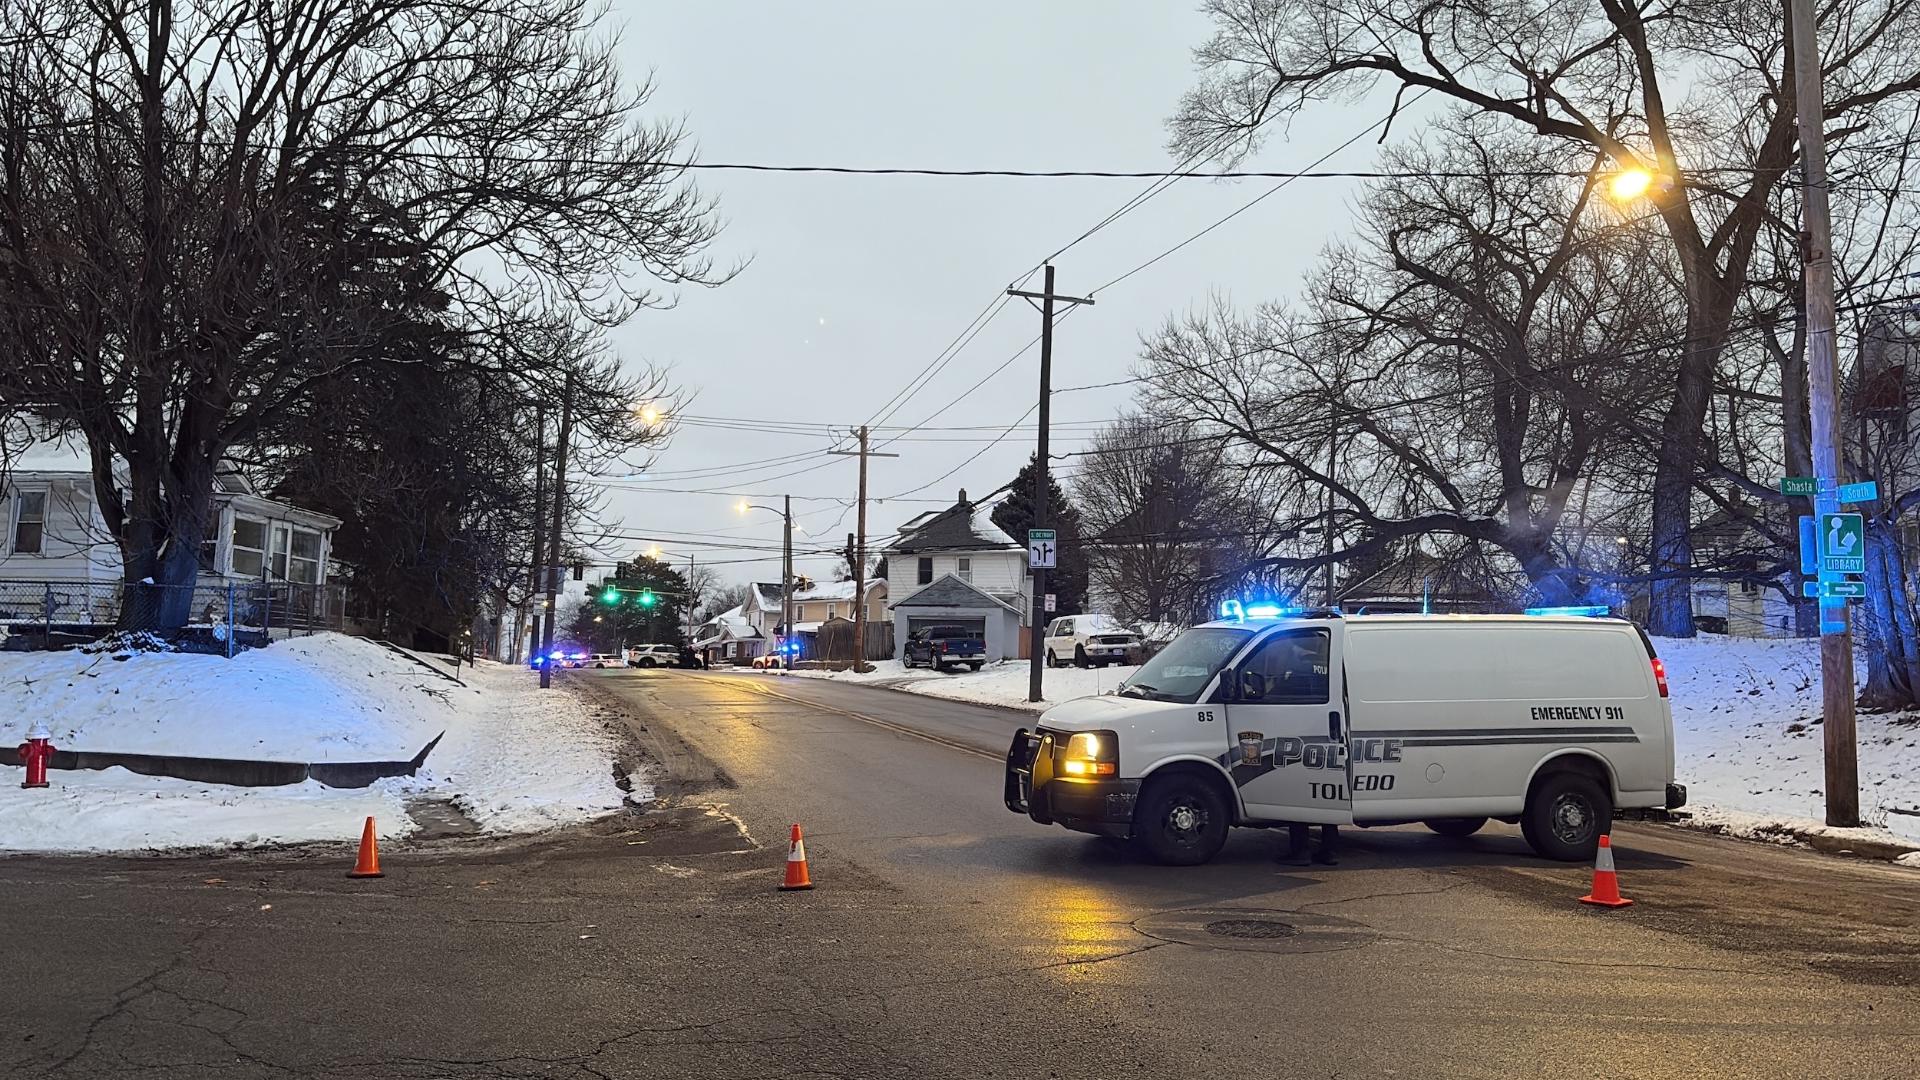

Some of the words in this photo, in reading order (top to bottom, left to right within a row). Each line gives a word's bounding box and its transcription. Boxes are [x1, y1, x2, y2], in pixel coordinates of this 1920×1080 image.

[1787, 481, 1812, 492] Shasta
[1848, 487, 1869, 499] South
[1827, 559, 1861, 570] LIBRARY
[1198, 711, 1214, 722] 85
[1531, 706, 1601, 720] EMERGENCY
[1605, 706, 1624, 720] 911
[1273, 737, 1403, 771] POLICE
[1309, 774, 1395, 801] TOLEDO
